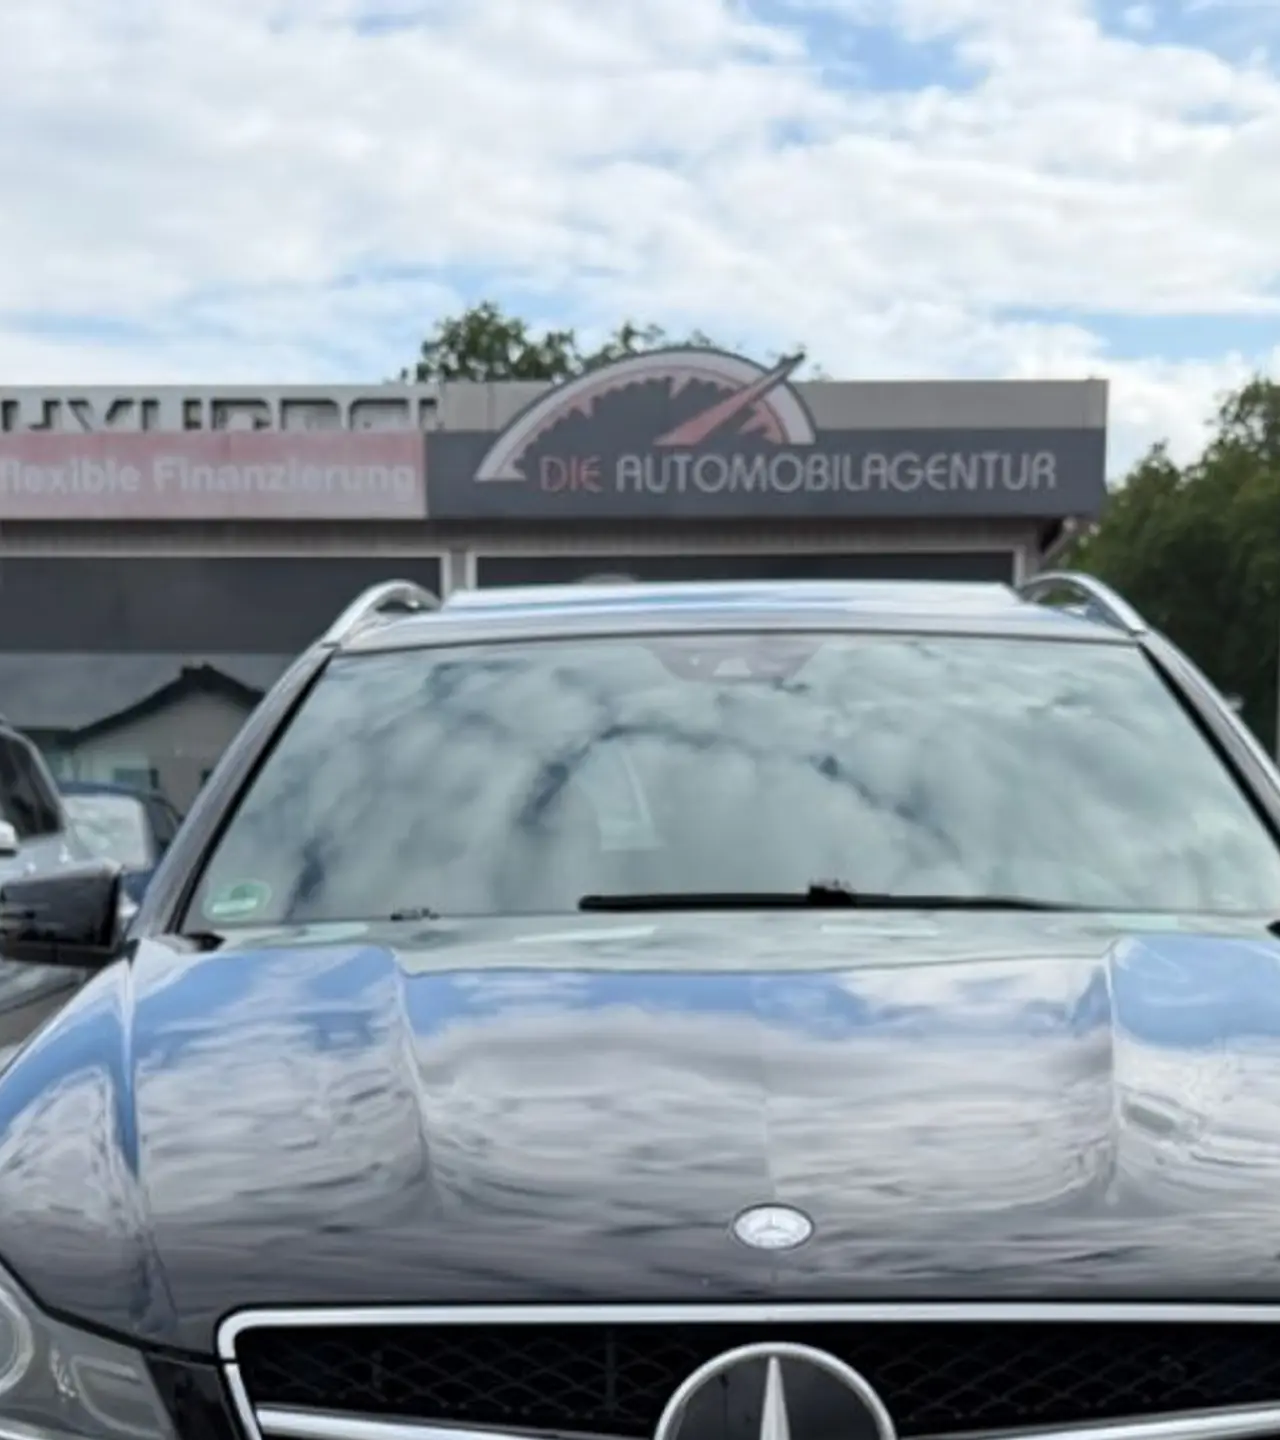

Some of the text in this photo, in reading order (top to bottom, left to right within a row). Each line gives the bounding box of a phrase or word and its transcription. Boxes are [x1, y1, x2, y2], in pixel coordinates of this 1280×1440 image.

[151, 456, 417, 498] Finanzierung
[540, 451, 1058, 494] DIE AUTOMOBILAGENTUR
